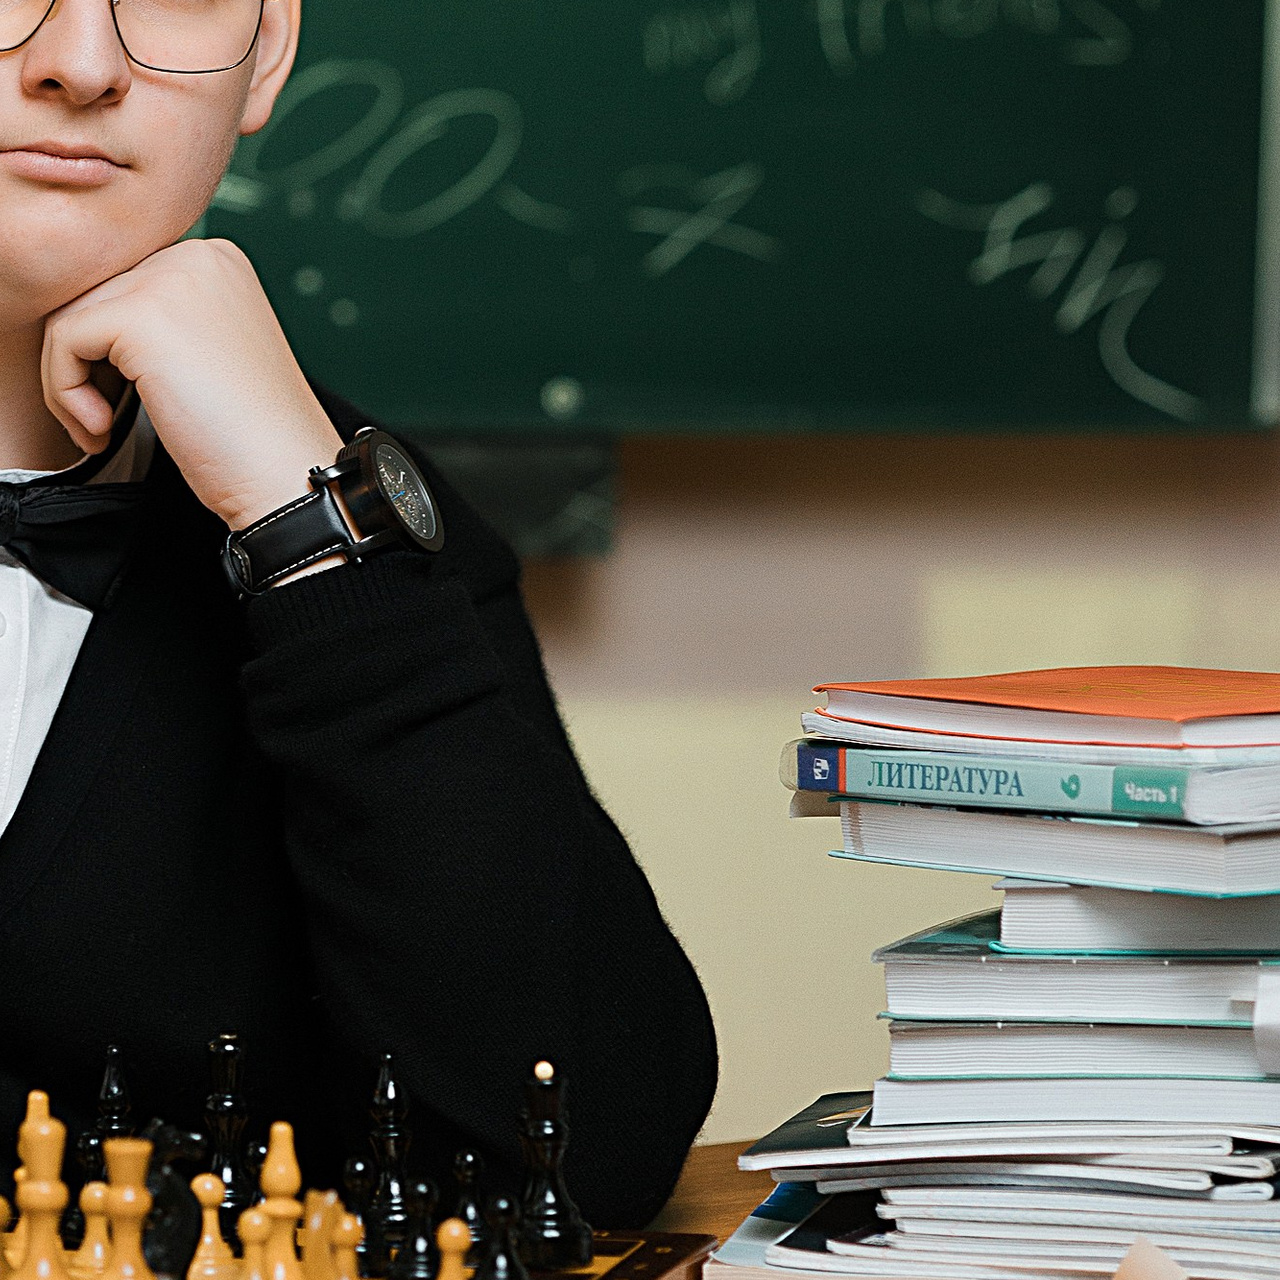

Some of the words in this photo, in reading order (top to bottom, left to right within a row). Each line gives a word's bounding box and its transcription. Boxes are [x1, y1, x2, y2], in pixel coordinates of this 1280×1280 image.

[867, 760, 1024, 798] ЛИТЕРАТУРА
[1124, 781, 1167, 804] Часть
[1169, 784, 1179, 804] 1
